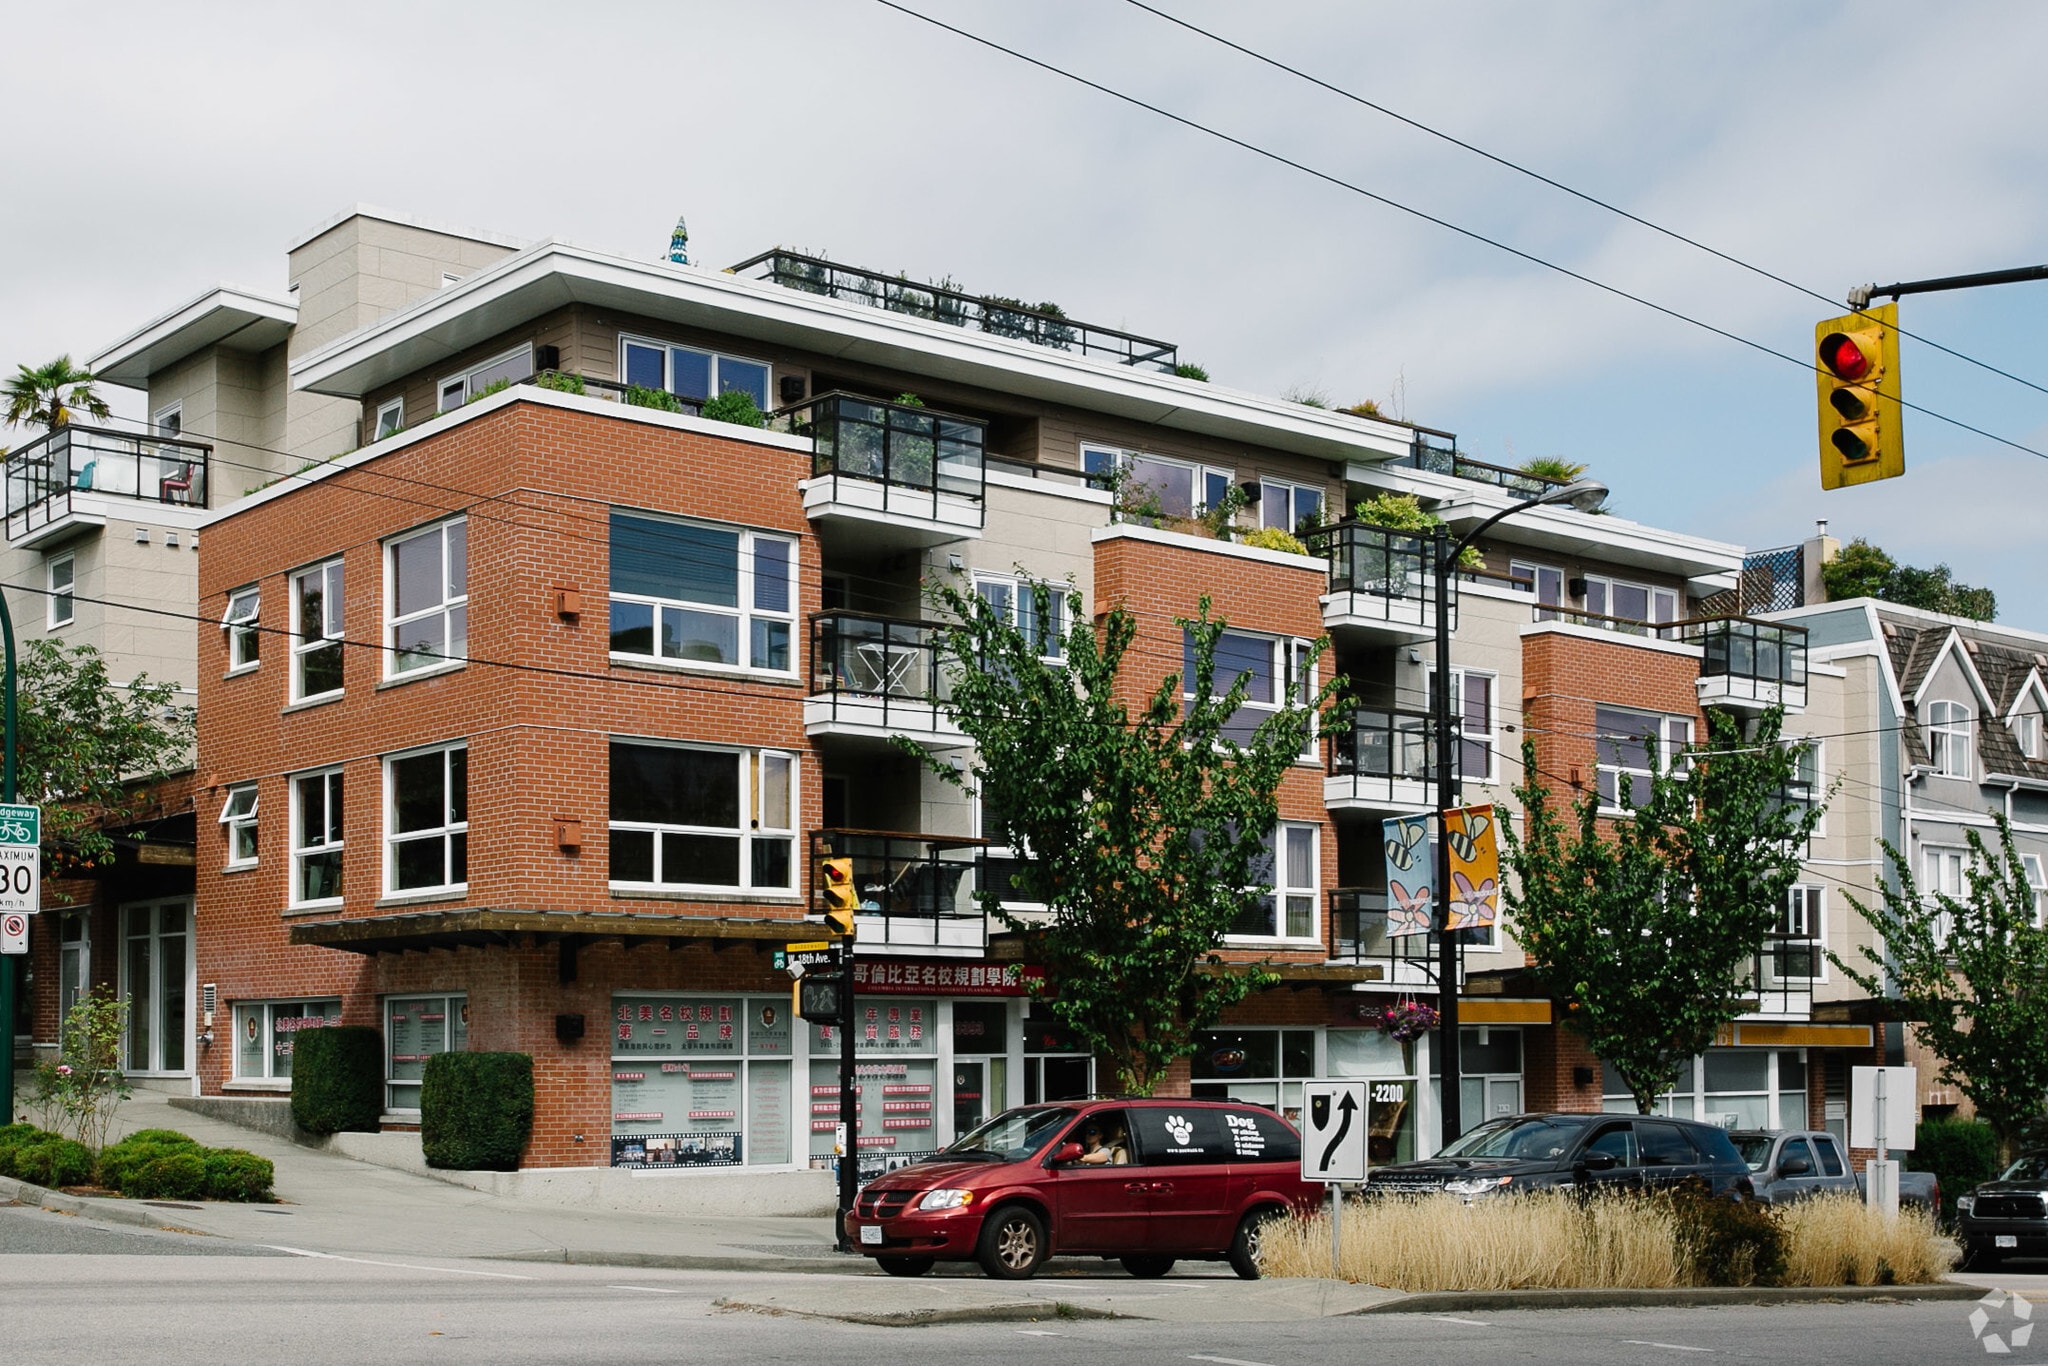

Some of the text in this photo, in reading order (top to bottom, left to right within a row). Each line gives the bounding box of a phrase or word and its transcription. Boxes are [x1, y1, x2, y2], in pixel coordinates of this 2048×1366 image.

[798, 953, 814, 964] 18th
[815, 952, 831, 964] Ave.
[1225, 1115, 1257, 1130] Dog
